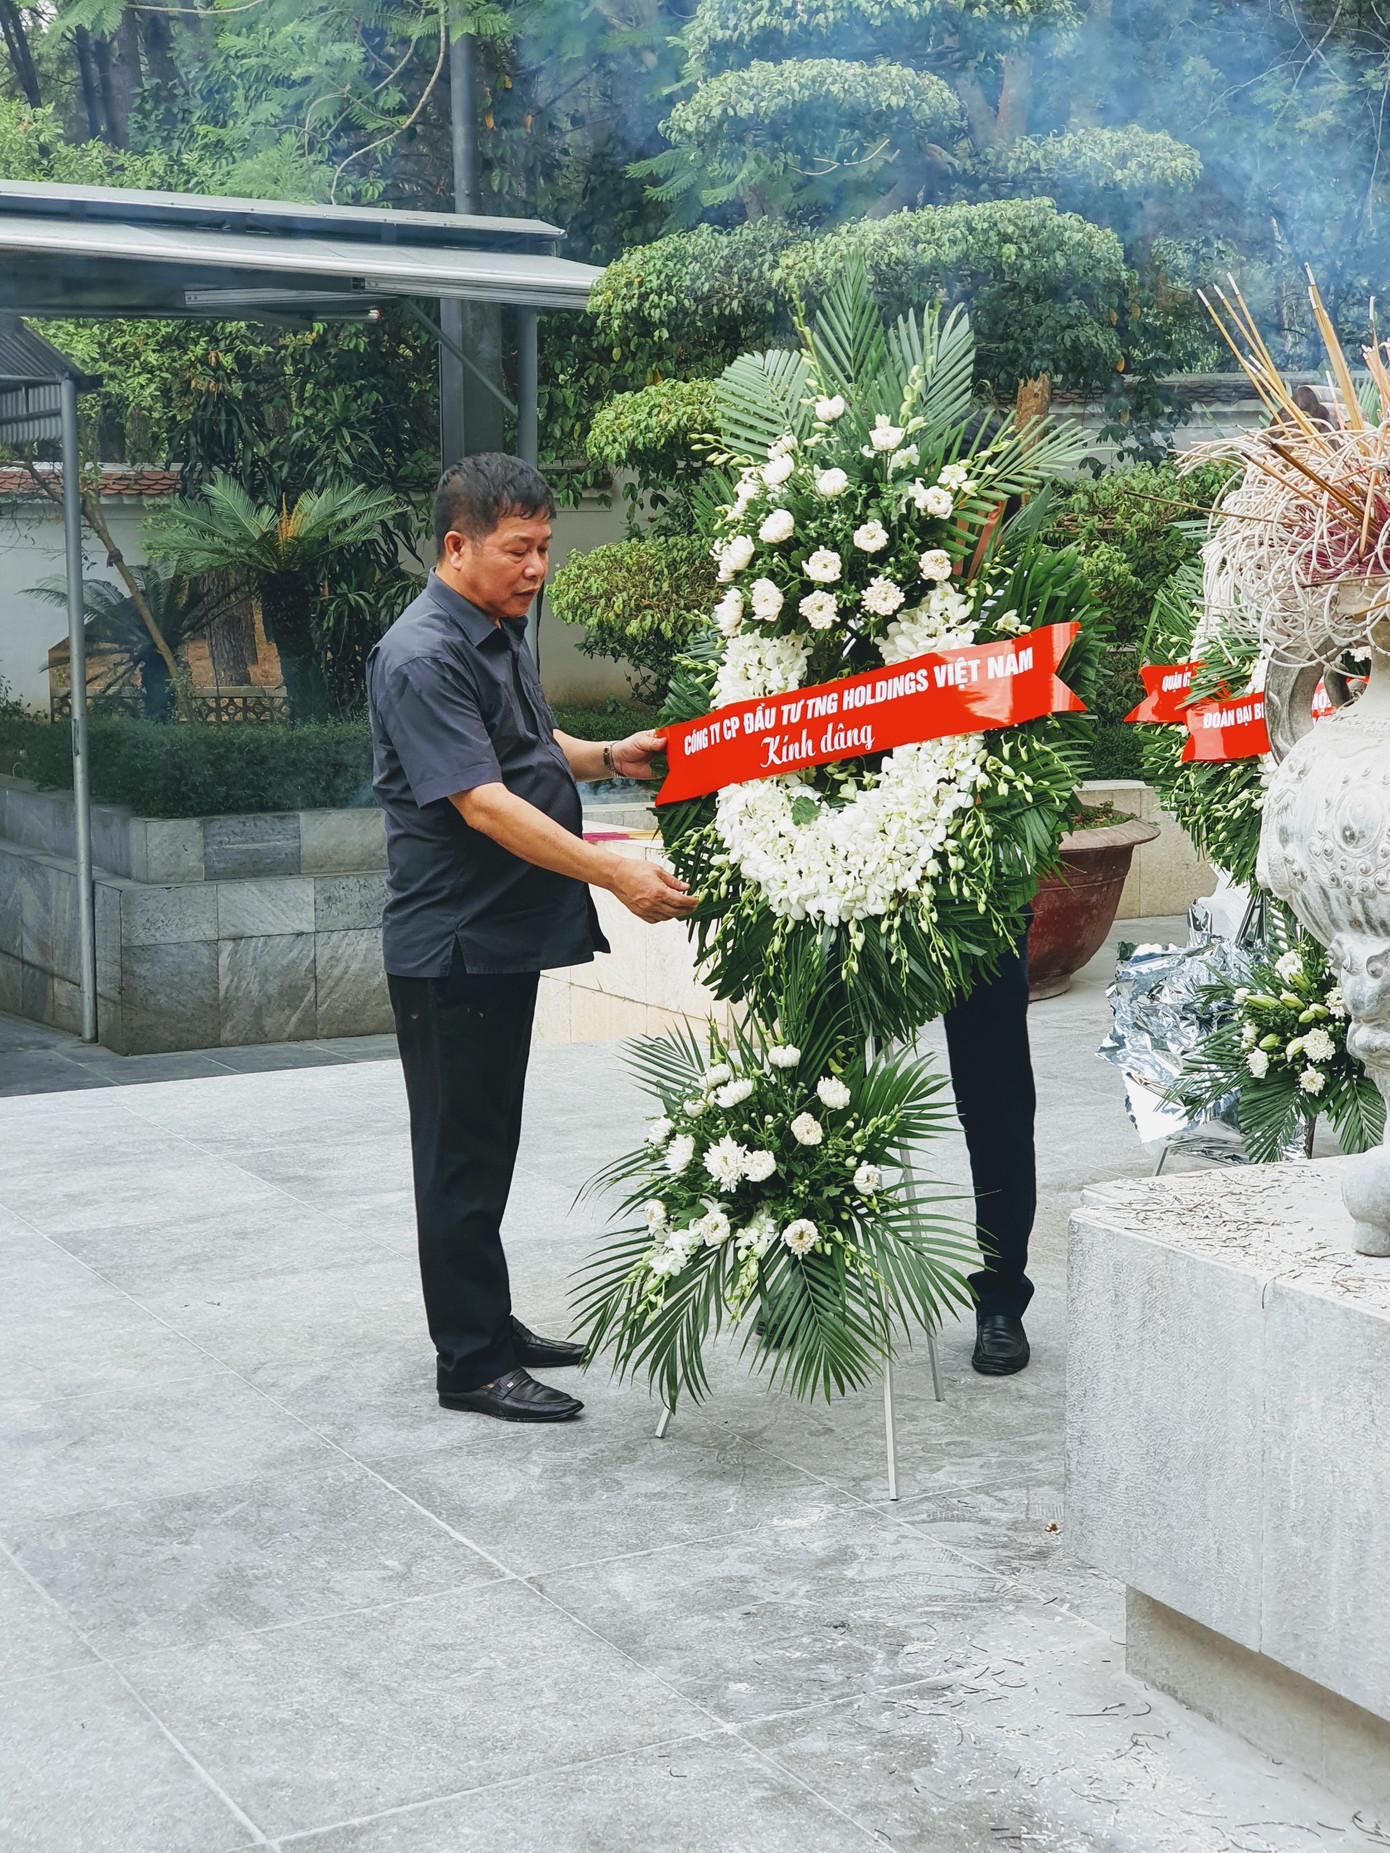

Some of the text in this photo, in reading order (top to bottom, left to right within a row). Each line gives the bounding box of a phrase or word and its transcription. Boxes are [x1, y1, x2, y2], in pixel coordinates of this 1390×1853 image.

[684, 646, 1033, 756] CÔNG TY CP ĐẦU TƯ TNG HOLDINGS VIỆT NAM
[1203, 708, 1235, 729] ĐOÀN
[1236, 704, 1253, 727] ĐẠI
[760, 722, 875, 768] Kính dâng
